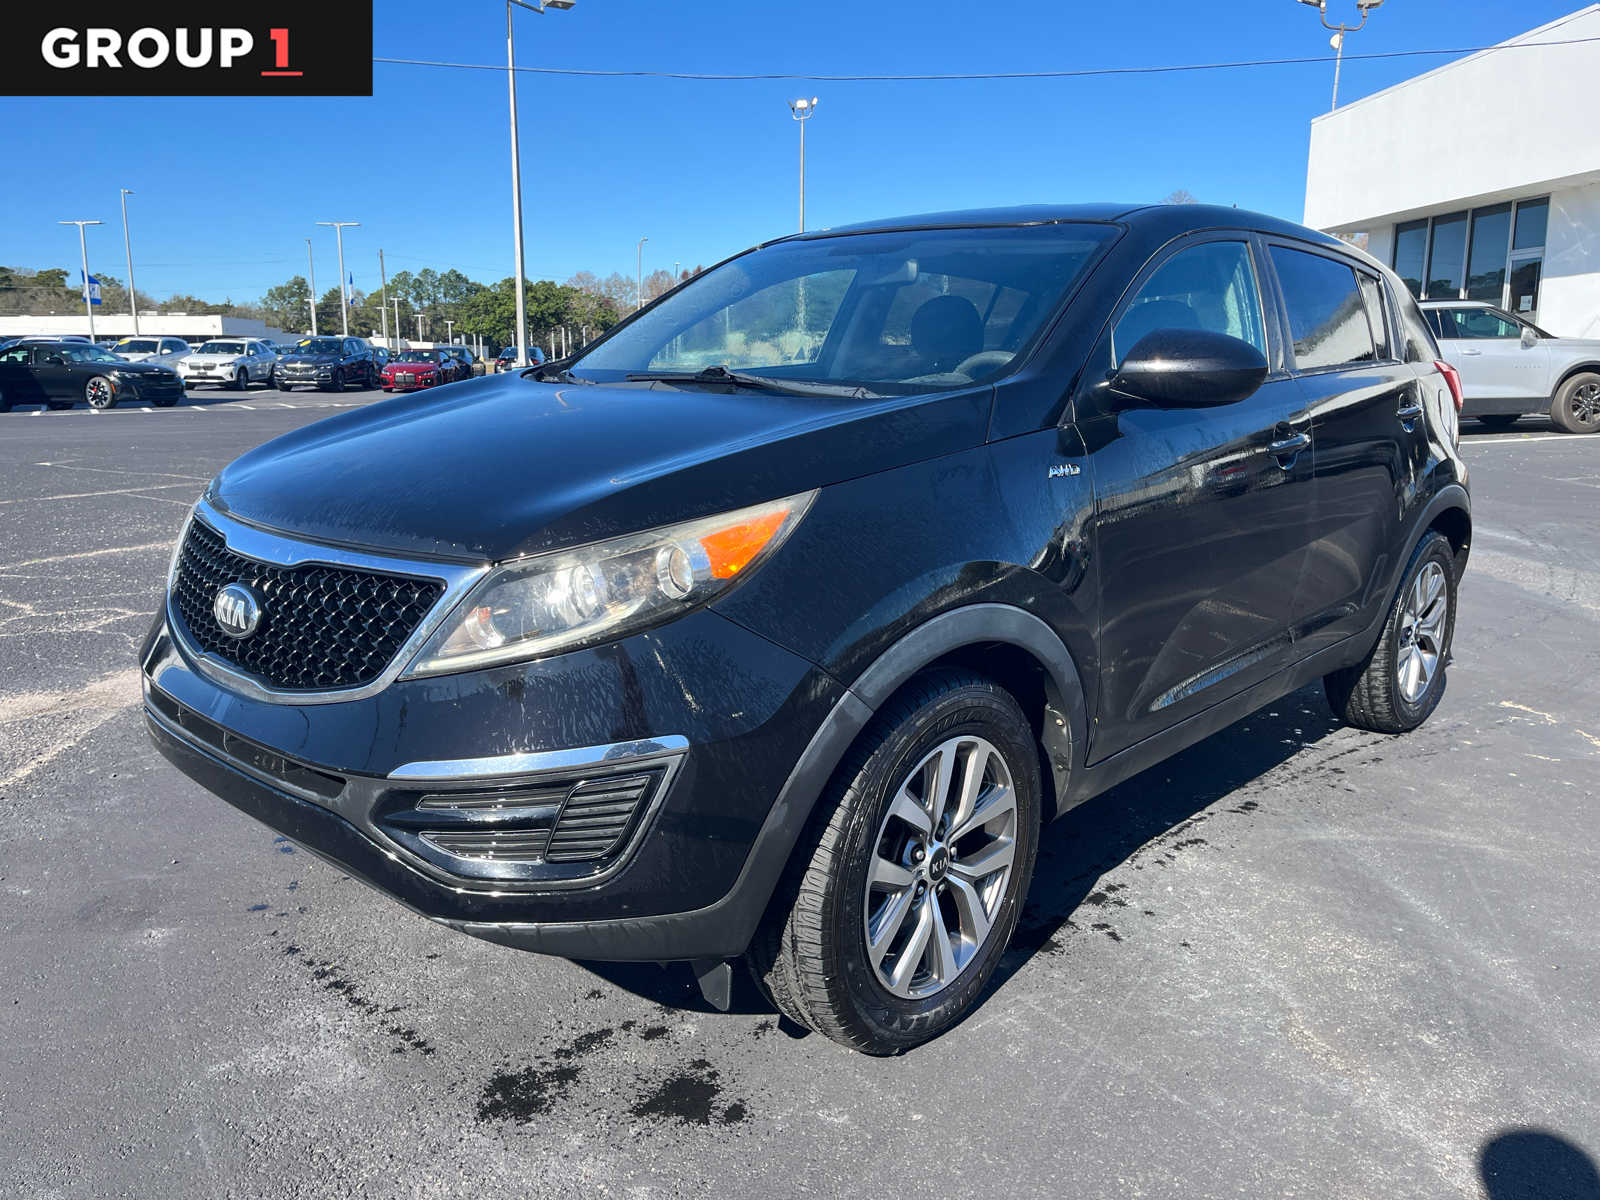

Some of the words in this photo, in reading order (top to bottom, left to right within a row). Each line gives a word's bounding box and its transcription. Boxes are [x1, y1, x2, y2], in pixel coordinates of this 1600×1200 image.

[1049, 464, 1081, 478] AWD
[216, 592, 247, 630] KIA
[932, 857, 948, 873] KIA
